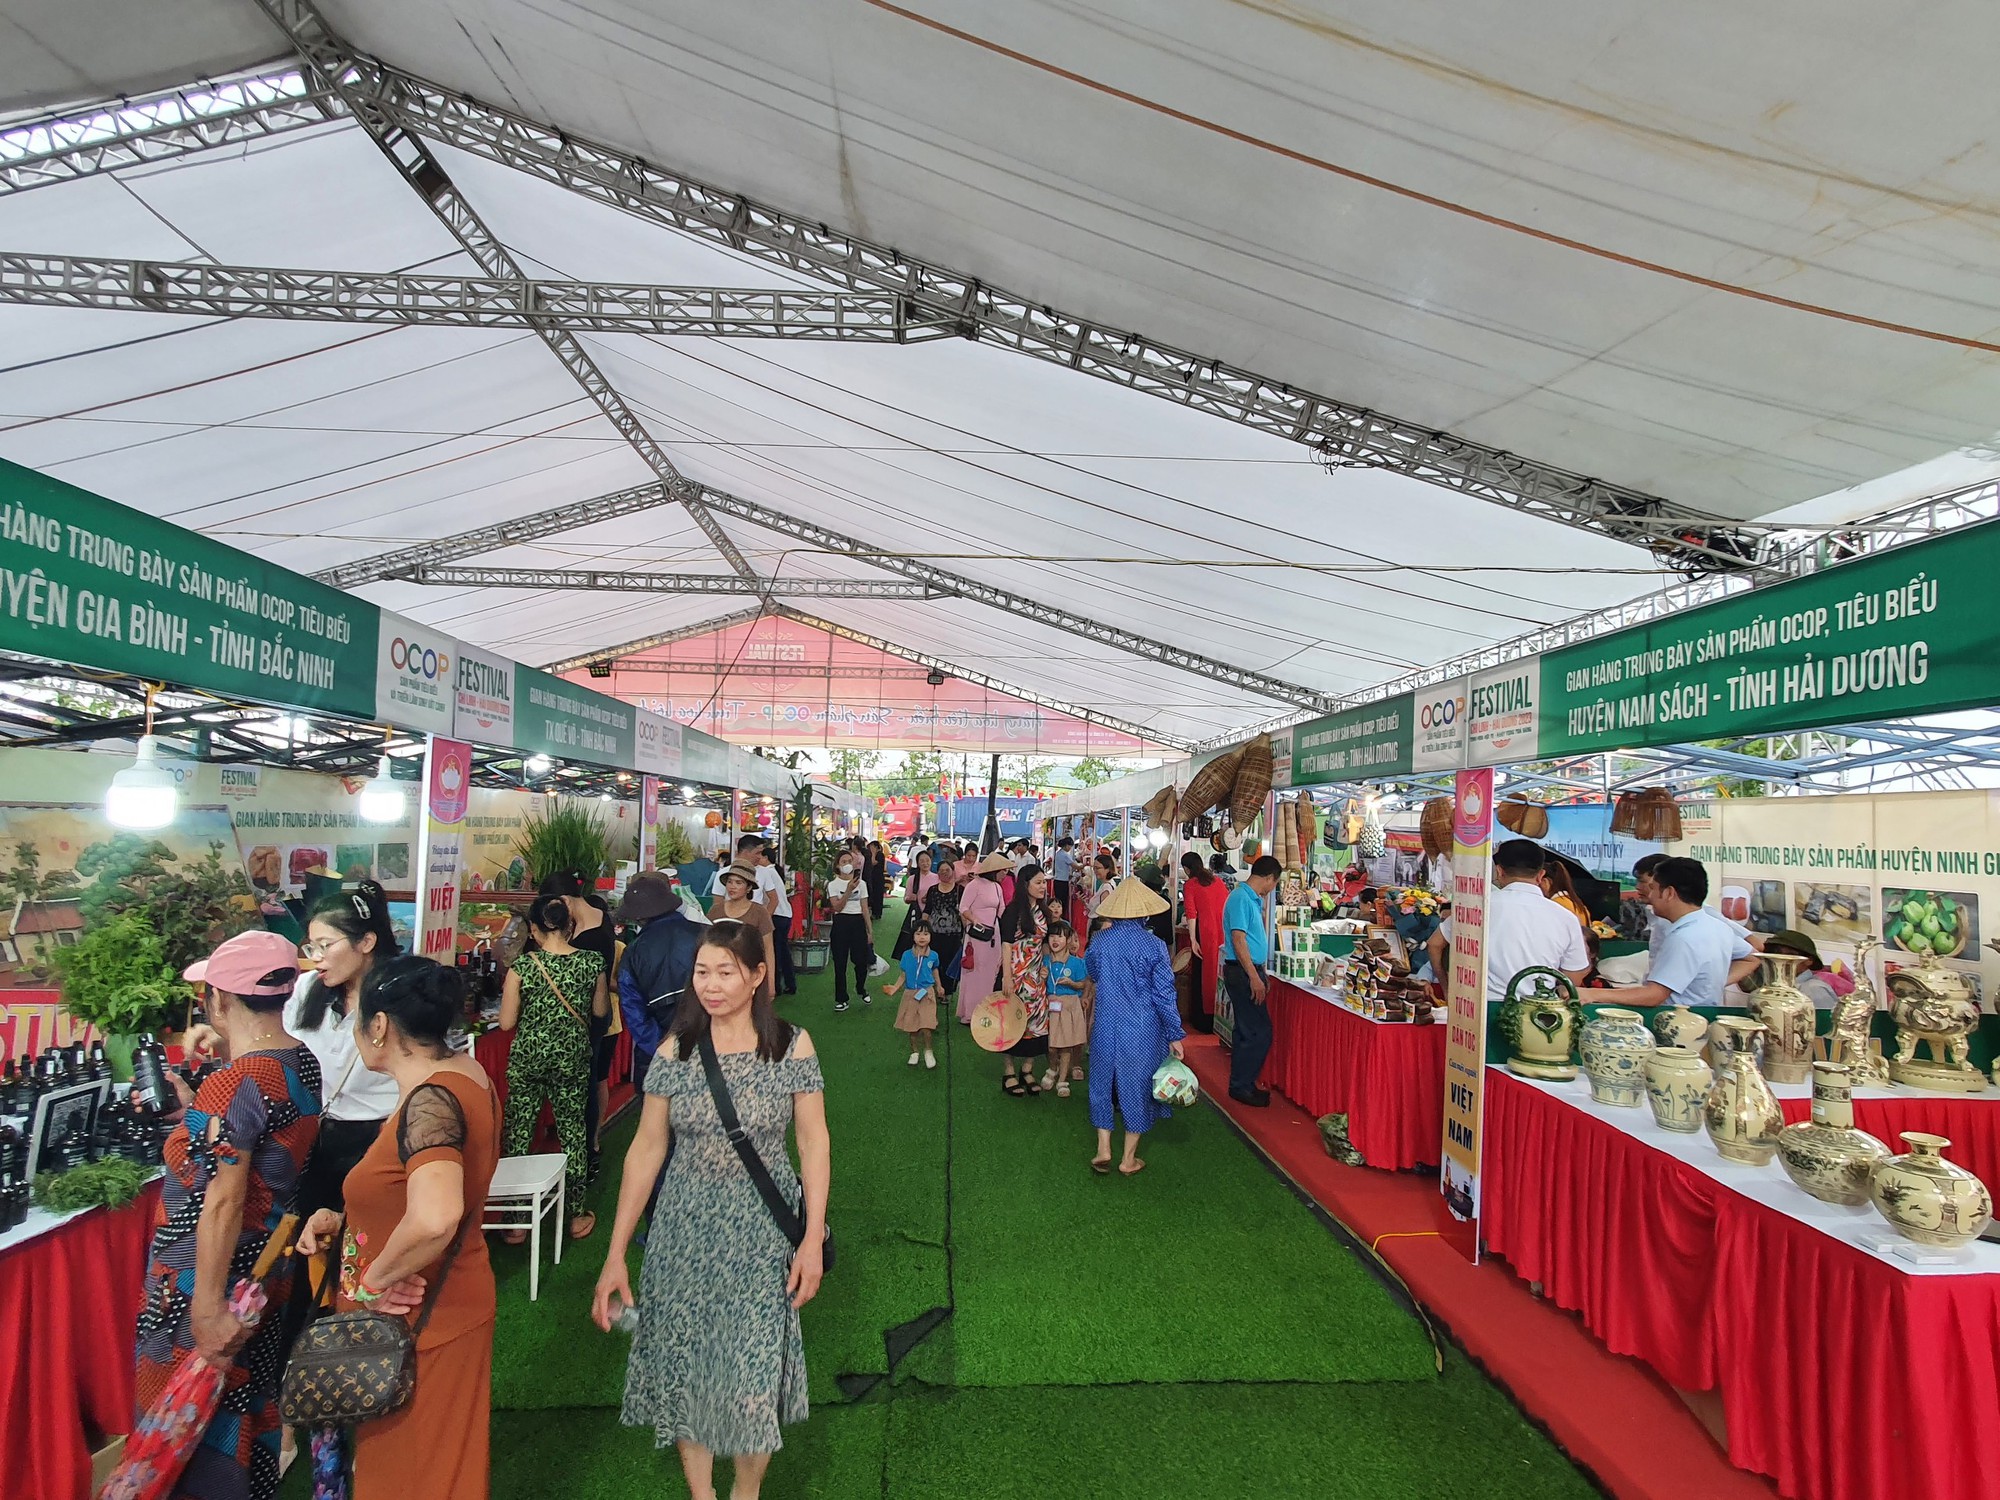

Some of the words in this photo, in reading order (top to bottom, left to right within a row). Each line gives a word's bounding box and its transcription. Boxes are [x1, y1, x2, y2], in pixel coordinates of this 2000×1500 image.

[66, 524, 135, 576] TRƯNG
[139, 549, 176, 589] BÀY
[179, 561, 213, 602] SẢN
[215, 577, 258, 616] PHẨM
[260, 592, 296, 631] OCOP,
[299, 605, 325, 637] TIÊU
[326, 612, 351, 645] BIỂU
[0, 567, 69, 630] YỆN
[76, 590, 122, 642] GIA
[129, 599, 188, 656] BÌNH
[194, 636, 203, 645] -
[209, 620, 256, 672] TỈNH
[259, 632, 294, 680] BẮC
[297, 650, 335, 690] NINH
[1566, 668, 1590, 692] GIAN
[1592, 660, 1622, 686] HÀNG
[1624, 649, 1663, 679] TRƯNG
[1666, 640, 1694, 670] BÀY
[1697, 629, 1726, 663] SẢN
[1729, 614, 1776, 656] PHẨM
[1780, 607, 1829, 638] OCOP,
[1835, 591, 1879, 631] TIÊU
[1885, 572, 1937, 621] BIỂU
[390, 637, 449, 681] OCOP
[459, 656, 510, 701] FESTIVAL
[1568, 697, 1615, 736] HUYỆN
[1619, 692, 1655, 729] NAM
[1659, 682, 1708, 722] SÁCH
[1726, 666, 1777, 711] TỈNH
[1783, 653, 1824, 703] HẢI
[1831, 641, 1928, 697] DƯƠNG
[1421, 697, 1465, 729] OCOP
[1469, 676, 1532, 720] FESTIVAL
[1364, 741, 1375, 764] HẢI
[221, 769, 257, 787] FESTIVAL
[236, 811, 257, 828] GIAN
[257, 808, 281, 828] HÀNG
[308, 810, 321, 828] BÀY
[323, 810, 338, 828] SẢN
[1679, 804, 1712, 819] ESTIVAL
[1690, 845, 1712, 863] GIAN
[1715, 843, 1741, 864] HÀNG
[1745, 846, 1780, 865] TRƯNG
[1784, 844, 1805, 867] BÀY
[1809, 843, 1833, 868] SẢN
[1837, 843, 1877, 869] PHẨM
[1881, 846, 1932, 875] HUYỆN
[1937, 851, 1978, 875] NINH
[430, 882, 455, 916] VIỆT
[1455, 875, 1468, 894] TINH
[1455, 902, 1465, 924] YÊU
[426, 928, 452, 954] NAM
[1455, 932, 1463, 954] VÀ
[1464, 966, 1476, 988] HÀO
[1450, 1082, 1474, 1114] VIỆT
[1448, 1118, 1473, 1151] NAM
